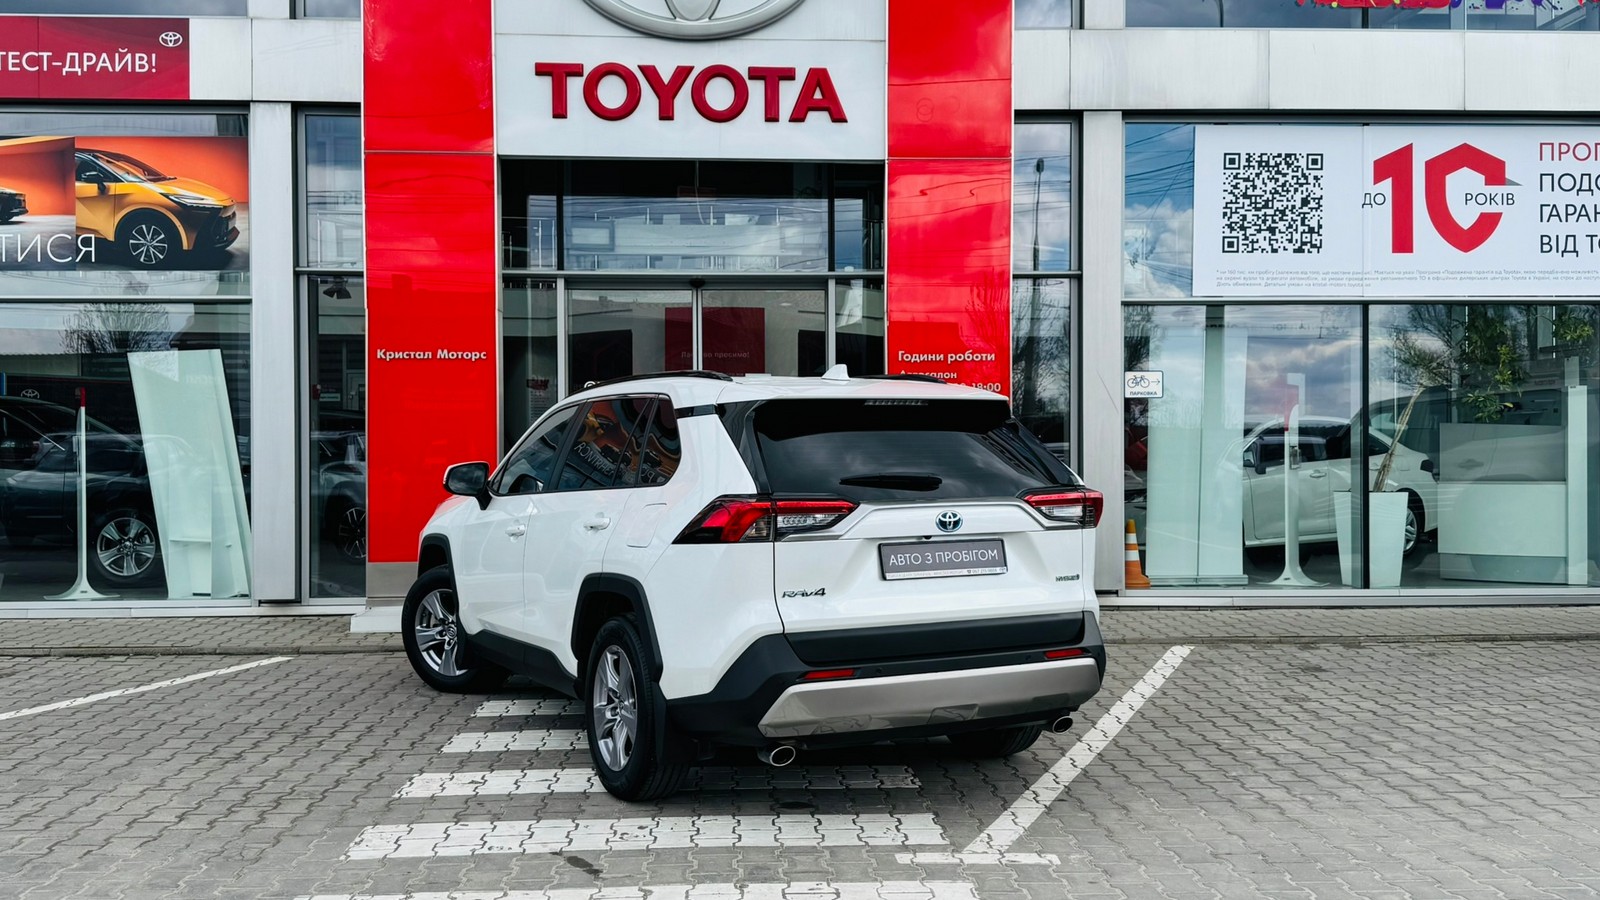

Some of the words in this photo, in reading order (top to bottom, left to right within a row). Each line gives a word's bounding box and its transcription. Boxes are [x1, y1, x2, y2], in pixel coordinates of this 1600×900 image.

[534, 62, 848, 123] TOYOTA
[1361, 192, 1387, 209] ДО
[1464, 192, 1516, 206] РОКІВ
[0, 233, 96, 263] ТИСЯ
[1540, 234, 1579, 258] ВІД
[1585, 234, 1600, 254] Т
[376, 348, 432, 361] Кристал
[436, 348, 487, 361] Моторс
[898, 350, 944, 363] Години
[947, 349, 996, 364] роботи
[889, 552, 922, 567] АВТО
[925, 552, 933, 564] З
[935, 549, 999, 563] ПРОБІГОМ
[781, 587, 827, 599] RAV4
